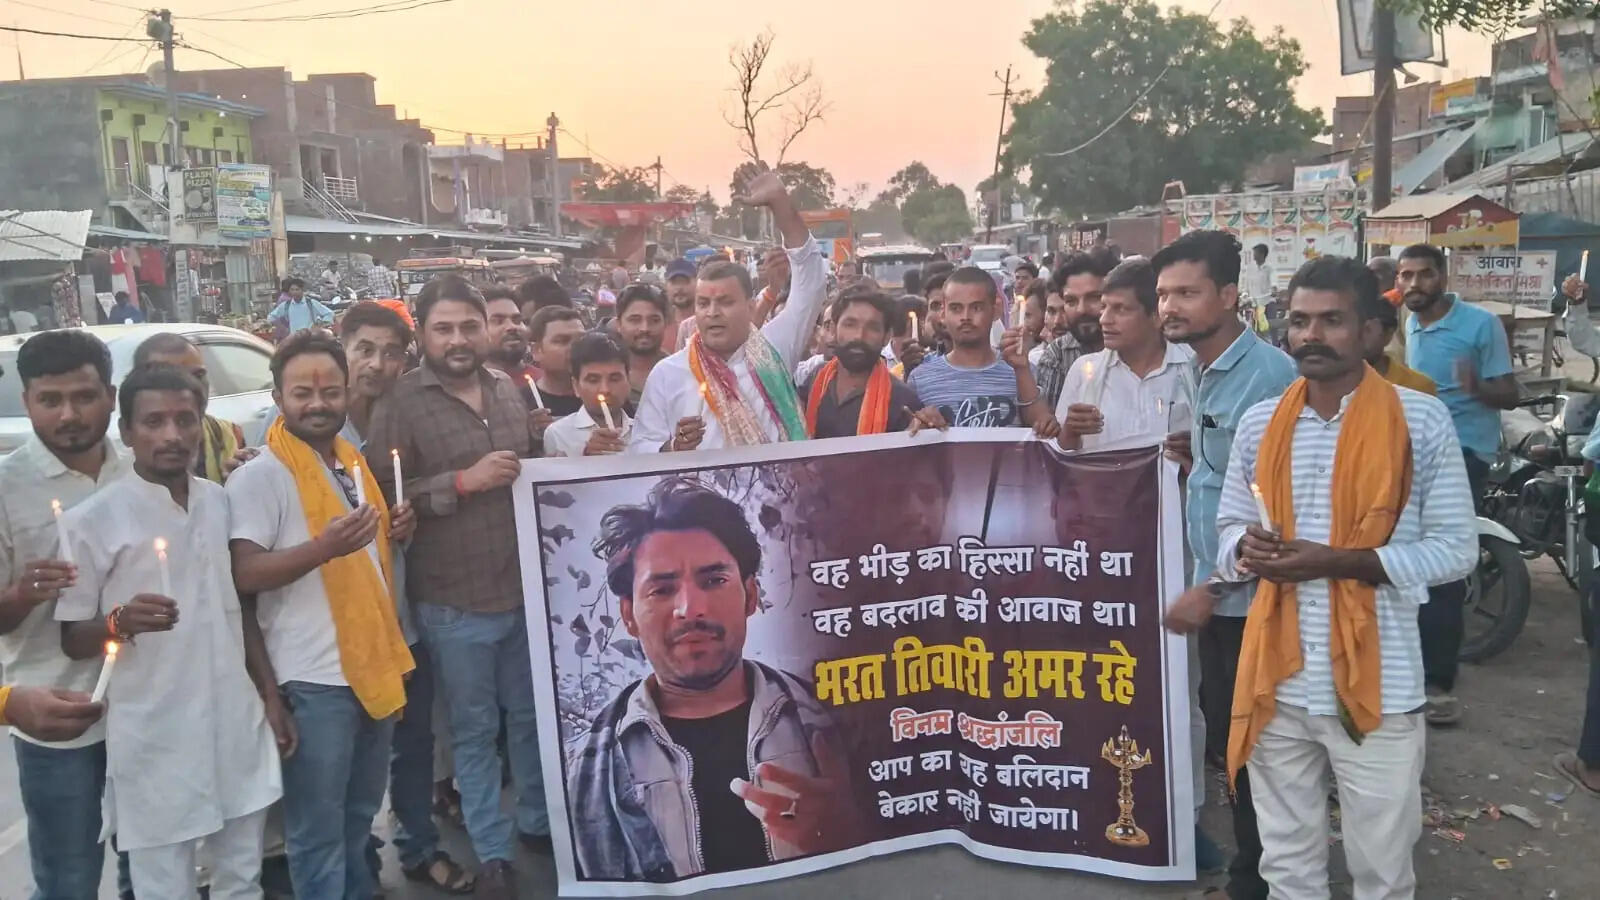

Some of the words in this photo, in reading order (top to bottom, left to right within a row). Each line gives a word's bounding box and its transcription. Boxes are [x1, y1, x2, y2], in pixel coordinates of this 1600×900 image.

[810, 558, 850, 589] वह
[858, 543, 911, 585] भीड़
[916, 545, 952, 571] का
[959, 538, 1034, 579] हिस्सा
[1100, 551, 1134, 577] था
[812, 607, 853, 637] वह
[860, 594, 947, 629] बदलाव
[954, 588, 989, 624] की
[998, 597, 1082, 625] आवाज
[815, 653, 886, 706] भरत
[892, 636, 994, 699] तिवारी
[1003, 651, 1086, 699] अमर
[1093, 640, 1137, 705] रहे
[890, 707, 954, 743] विनम्र
[957, 710, 1063, 750] श्रद्धांजलि
[868, 755, 914, 782] आप
[920, 750, 953, 772] का
[959, 752, 989, 787] यह
[996, 754, 1090, 790] बलिदान
[878, 789, 939, 819] बेकार
[946, 788, 982, 822] नही
